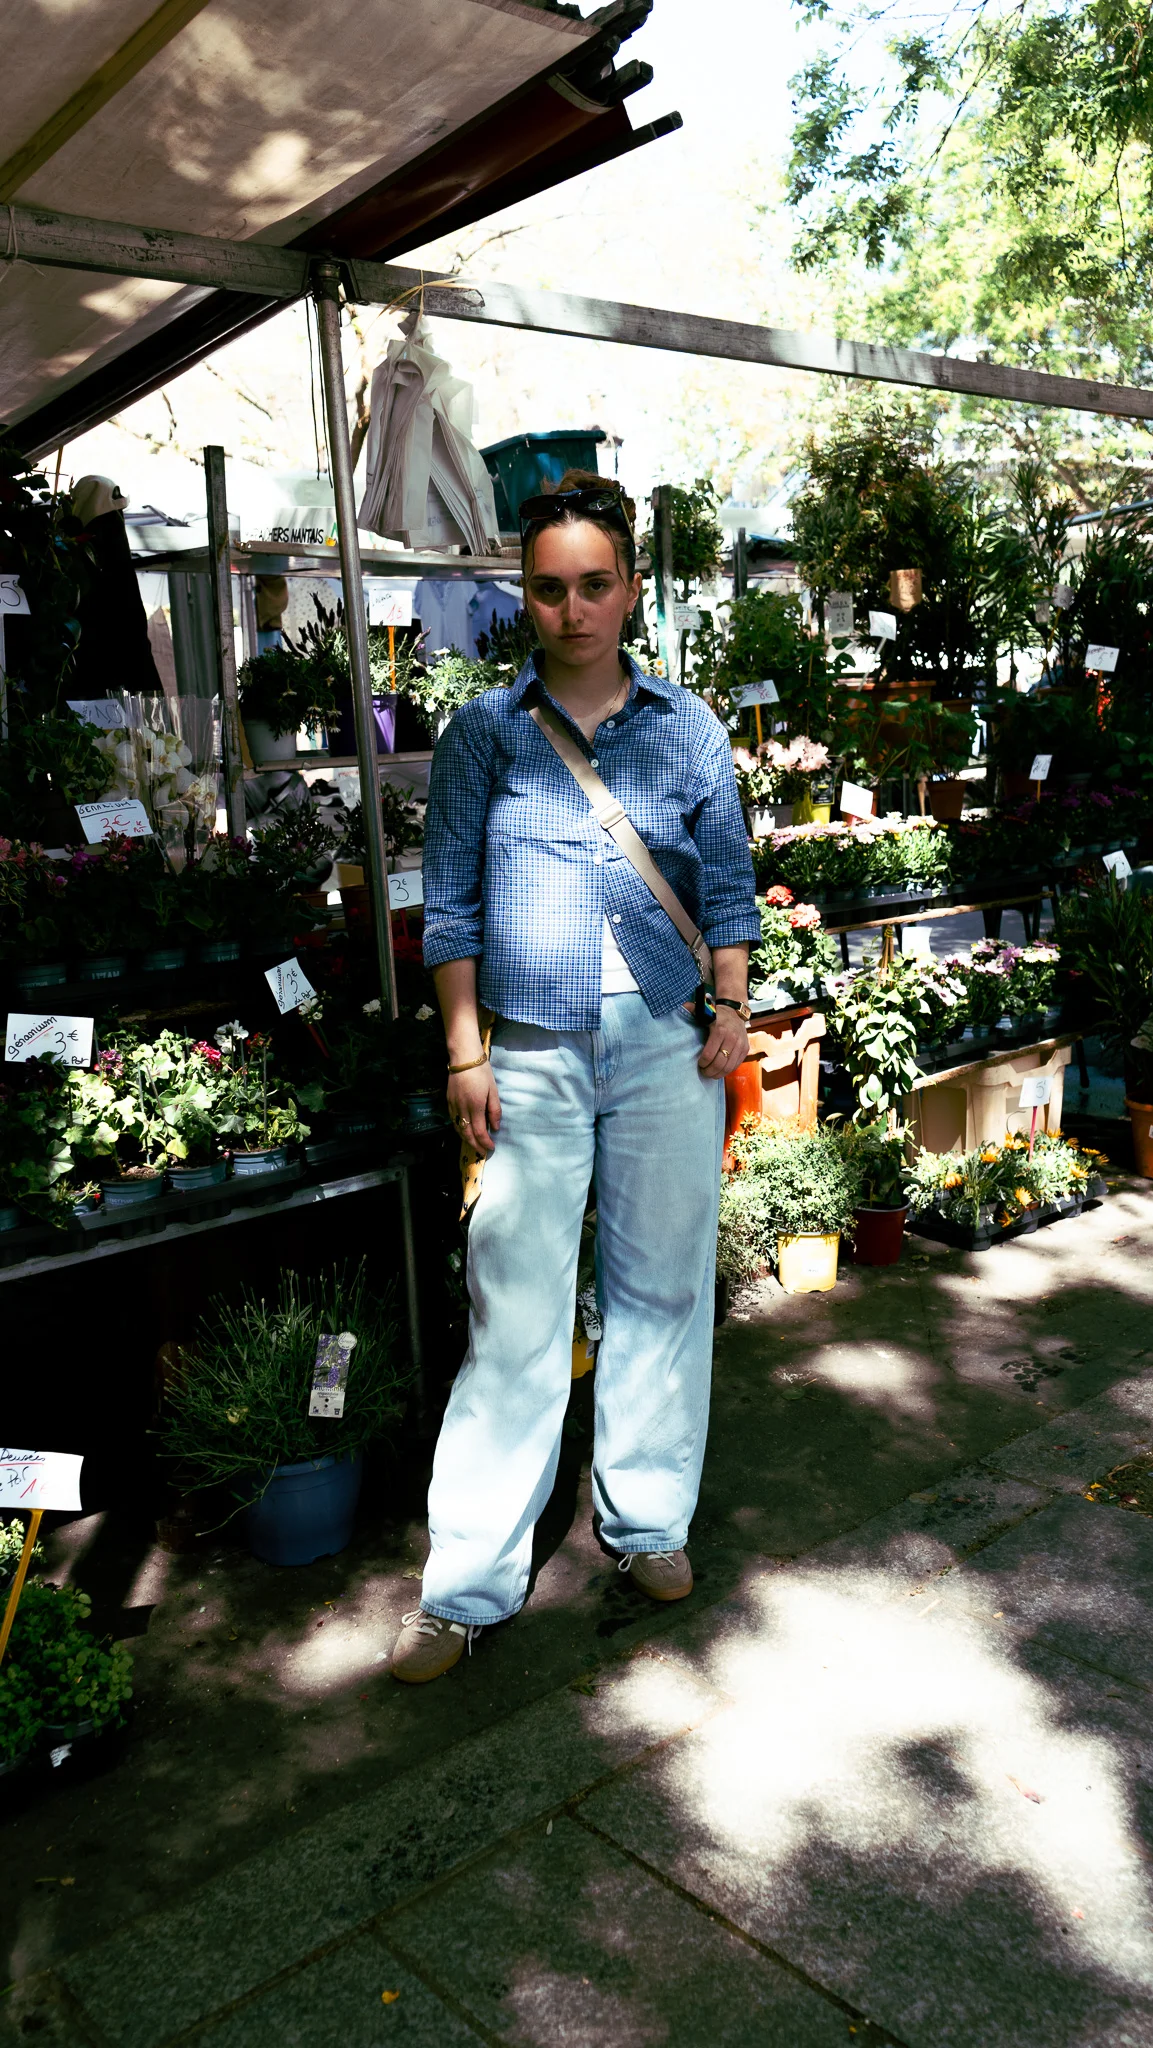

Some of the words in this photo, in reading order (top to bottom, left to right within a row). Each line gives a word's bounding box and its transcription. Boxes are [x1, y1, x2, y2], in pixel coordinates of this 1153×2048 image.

[390, 878, 410, 902] 3€
[8, 1016, 58, 1061] géranium
[54, 1029, 79, 1055] 3€
